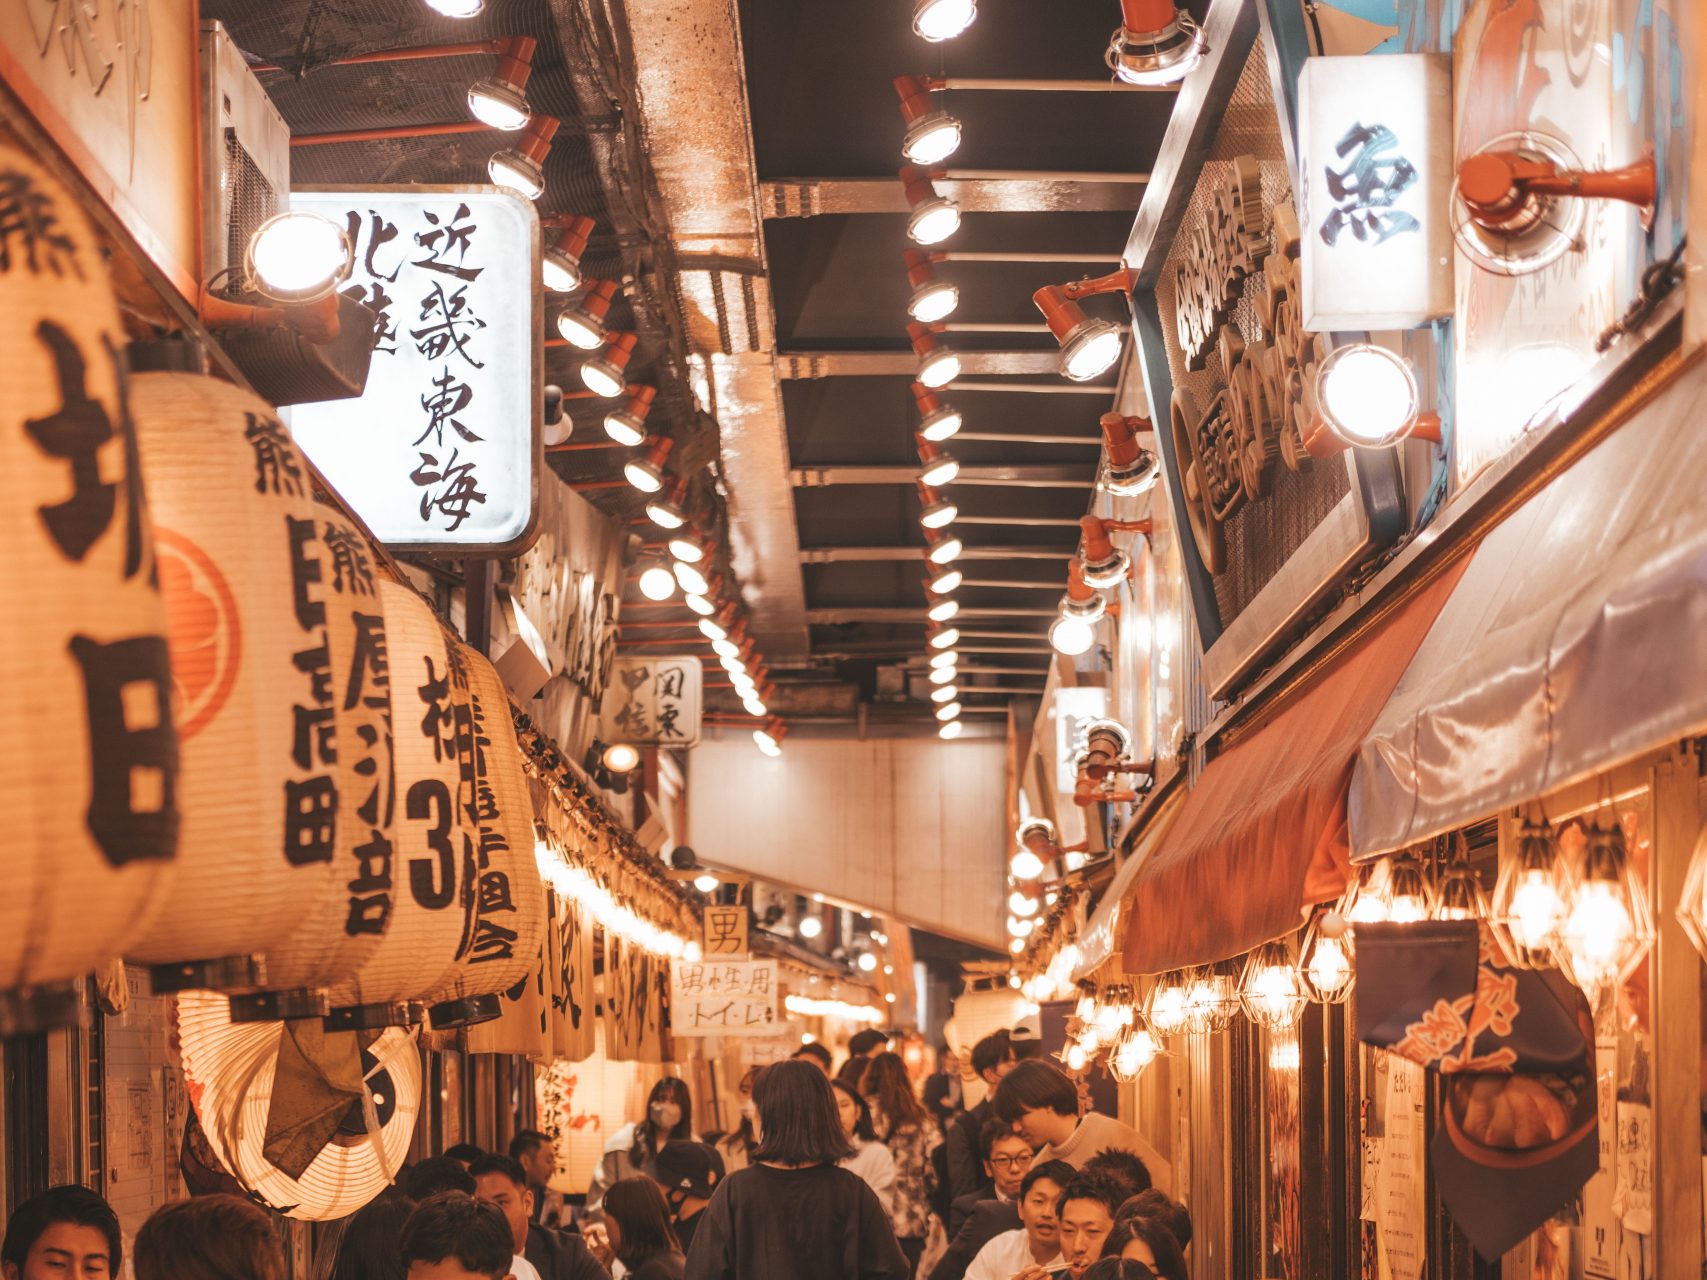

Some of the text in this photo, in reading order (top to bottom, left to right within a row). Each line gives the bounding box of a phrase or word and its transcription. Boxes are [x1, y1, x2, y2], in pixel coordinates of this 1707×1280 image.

[1318, 120, 1422, 248] 魚
[409, 201, 488, 533] 近畿東海
[708, 912, 742, 954] 男
[679, 965, 771, 995] 男性用
[694, 1001, 761, 1027] トイレ
